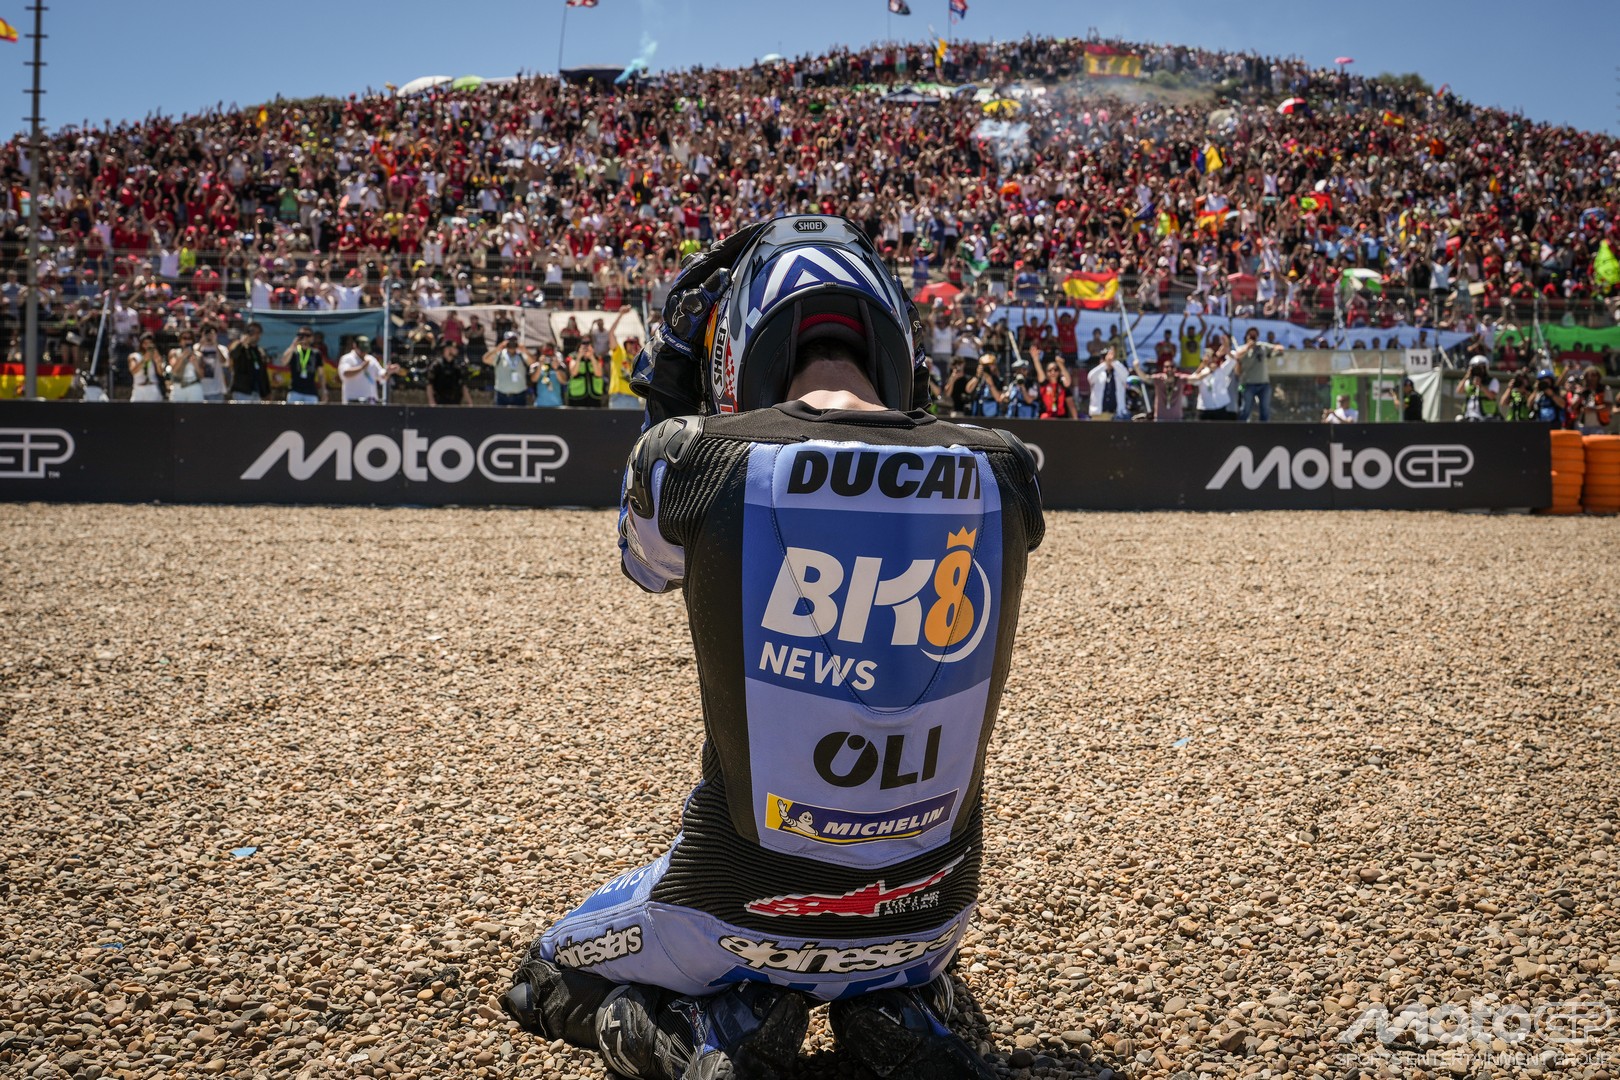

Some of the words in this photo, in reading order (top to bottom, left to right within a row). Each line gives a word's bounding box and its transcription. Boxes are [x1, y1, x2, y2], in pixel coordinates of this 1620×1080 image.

[798, 221, 823, 231] SHOEI
[713, 327, 727, 387] SHOEI
[240, 428, 570, 484] MotoGP
[1205, 442, 1475, 488] MotoGP
[760, 547, 975, 648] BK8
[759, 641, 879, 692] NEWS
[822, 806, 946, 837] MICHELIN
[718, 921, 960, 974] alpinestars
